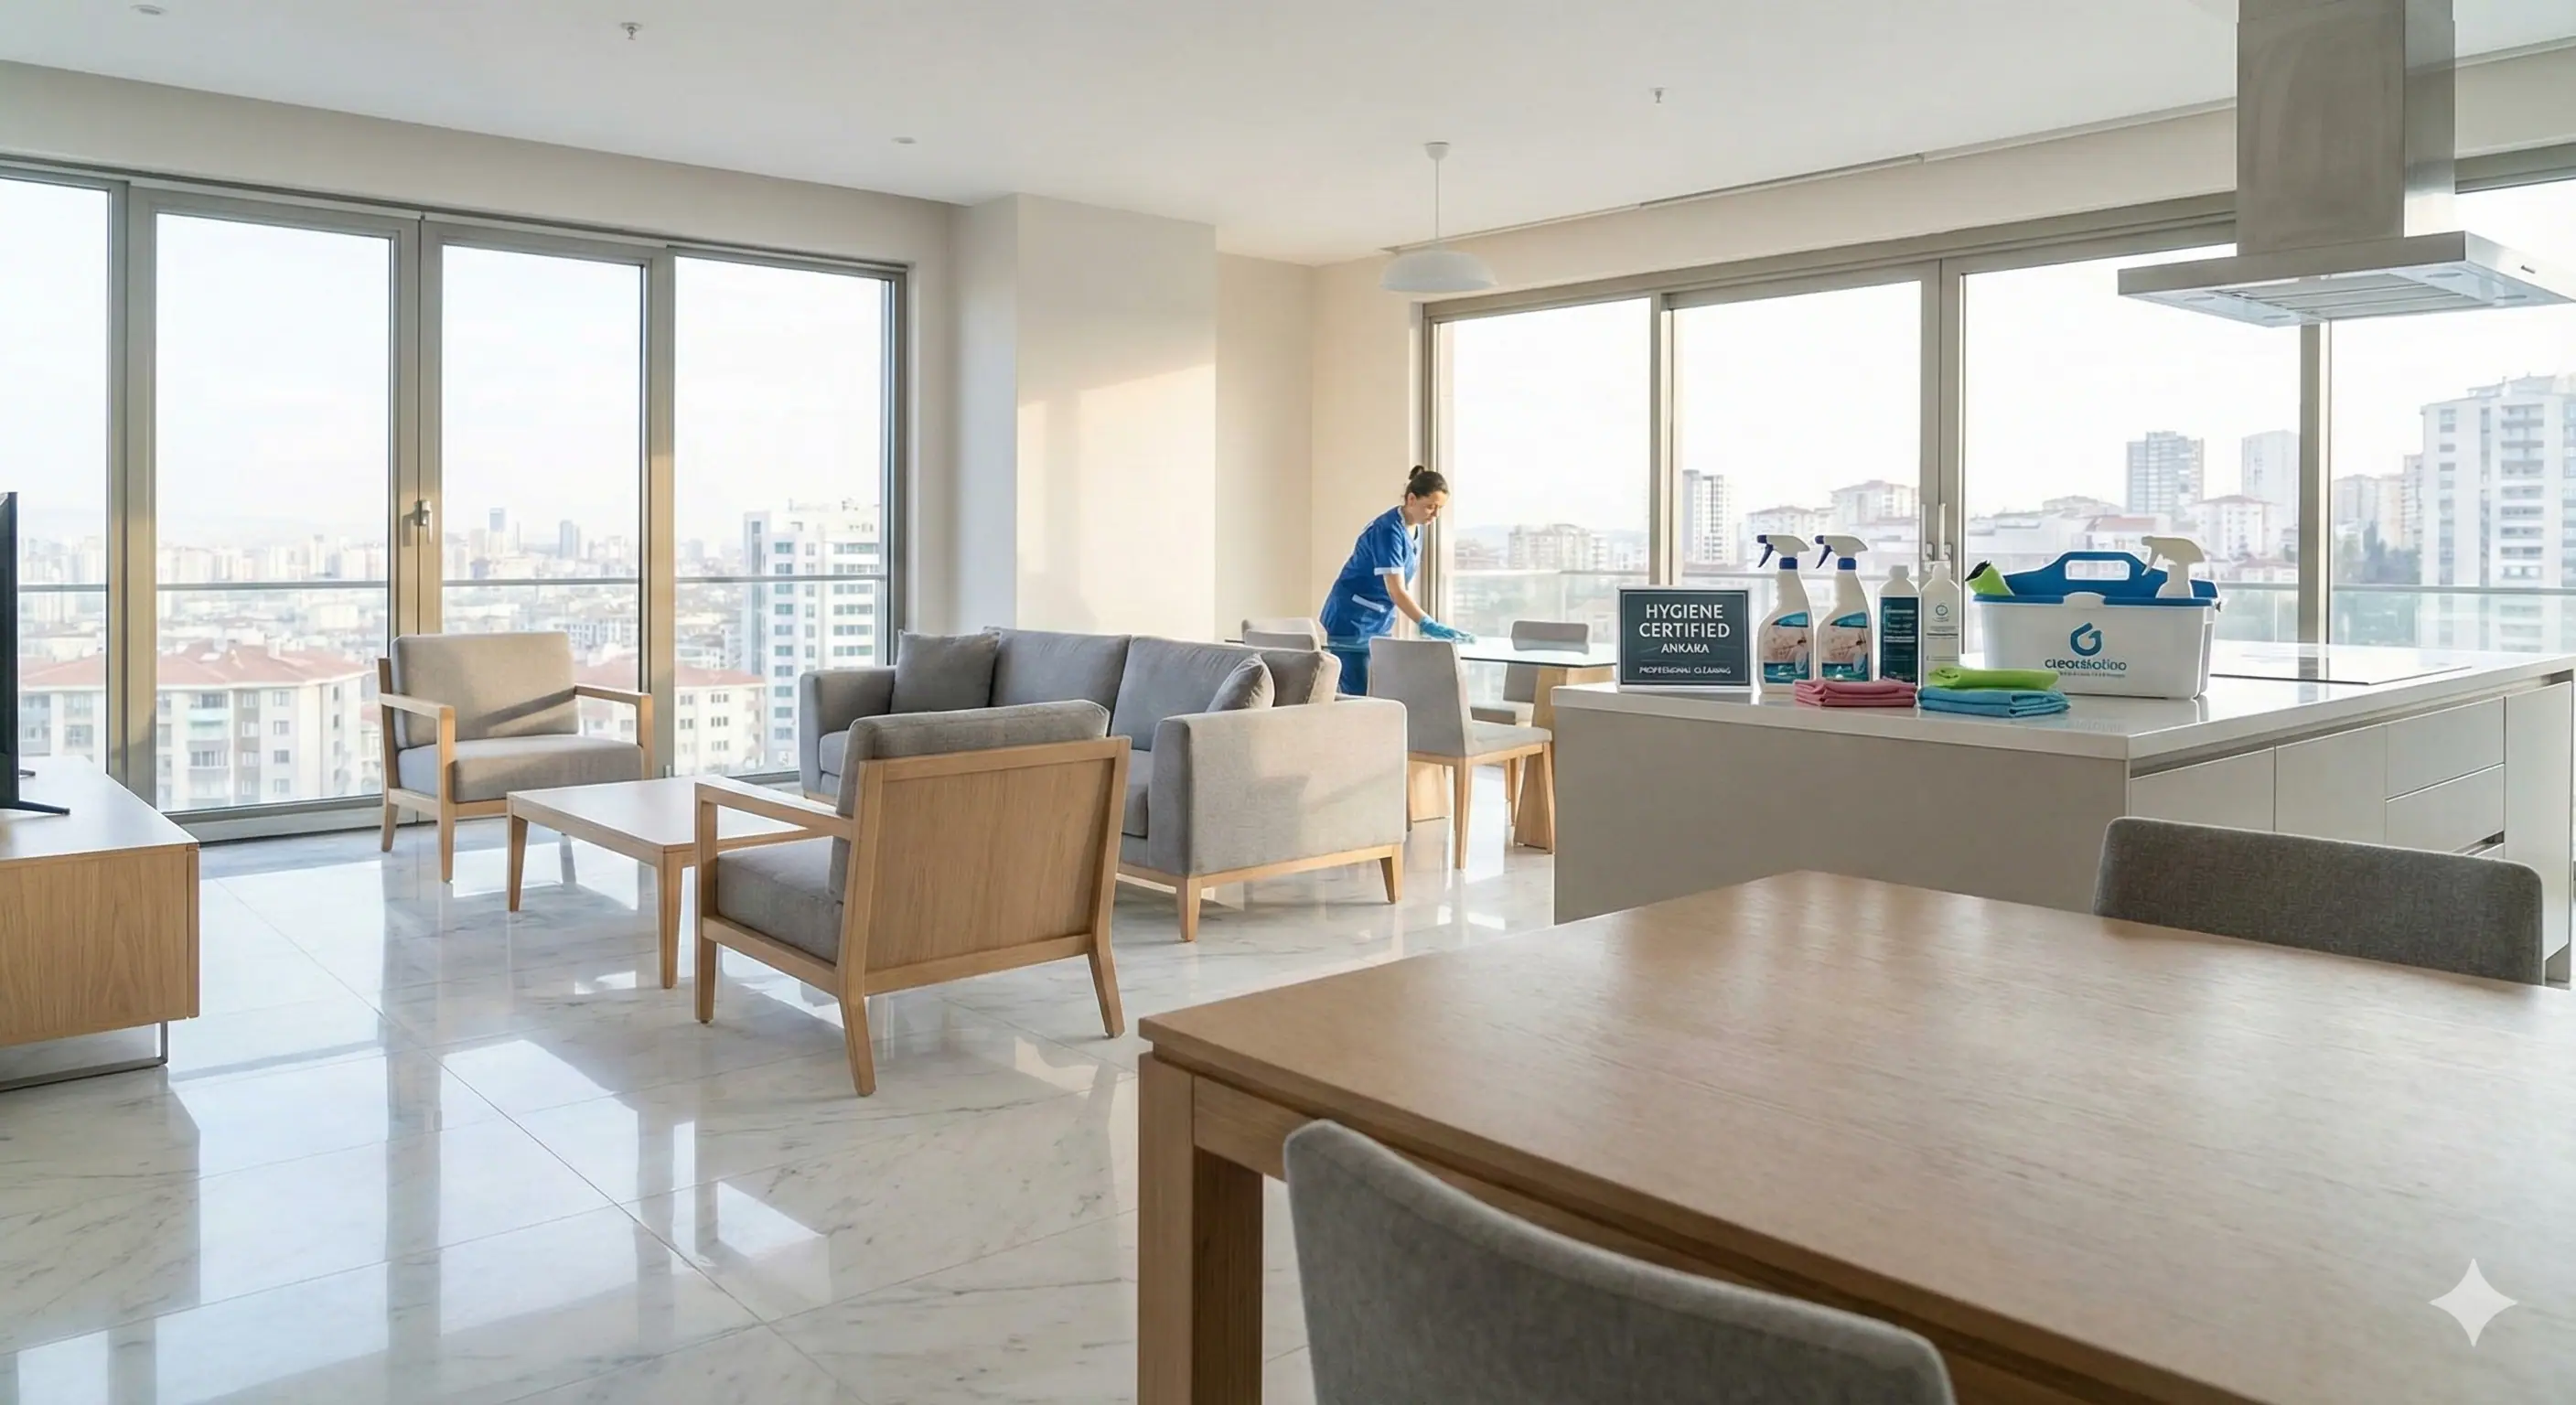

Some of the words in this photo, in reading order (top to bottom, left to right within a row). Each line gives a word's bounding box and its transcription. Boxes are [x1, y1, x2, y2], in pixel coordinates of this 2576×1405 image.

[1646, 604, 1723, 619] HYGIENE
[1638, 622, 1731, 638] CERTIFIED
[1660, 643, 1710, 653] ANKARA
